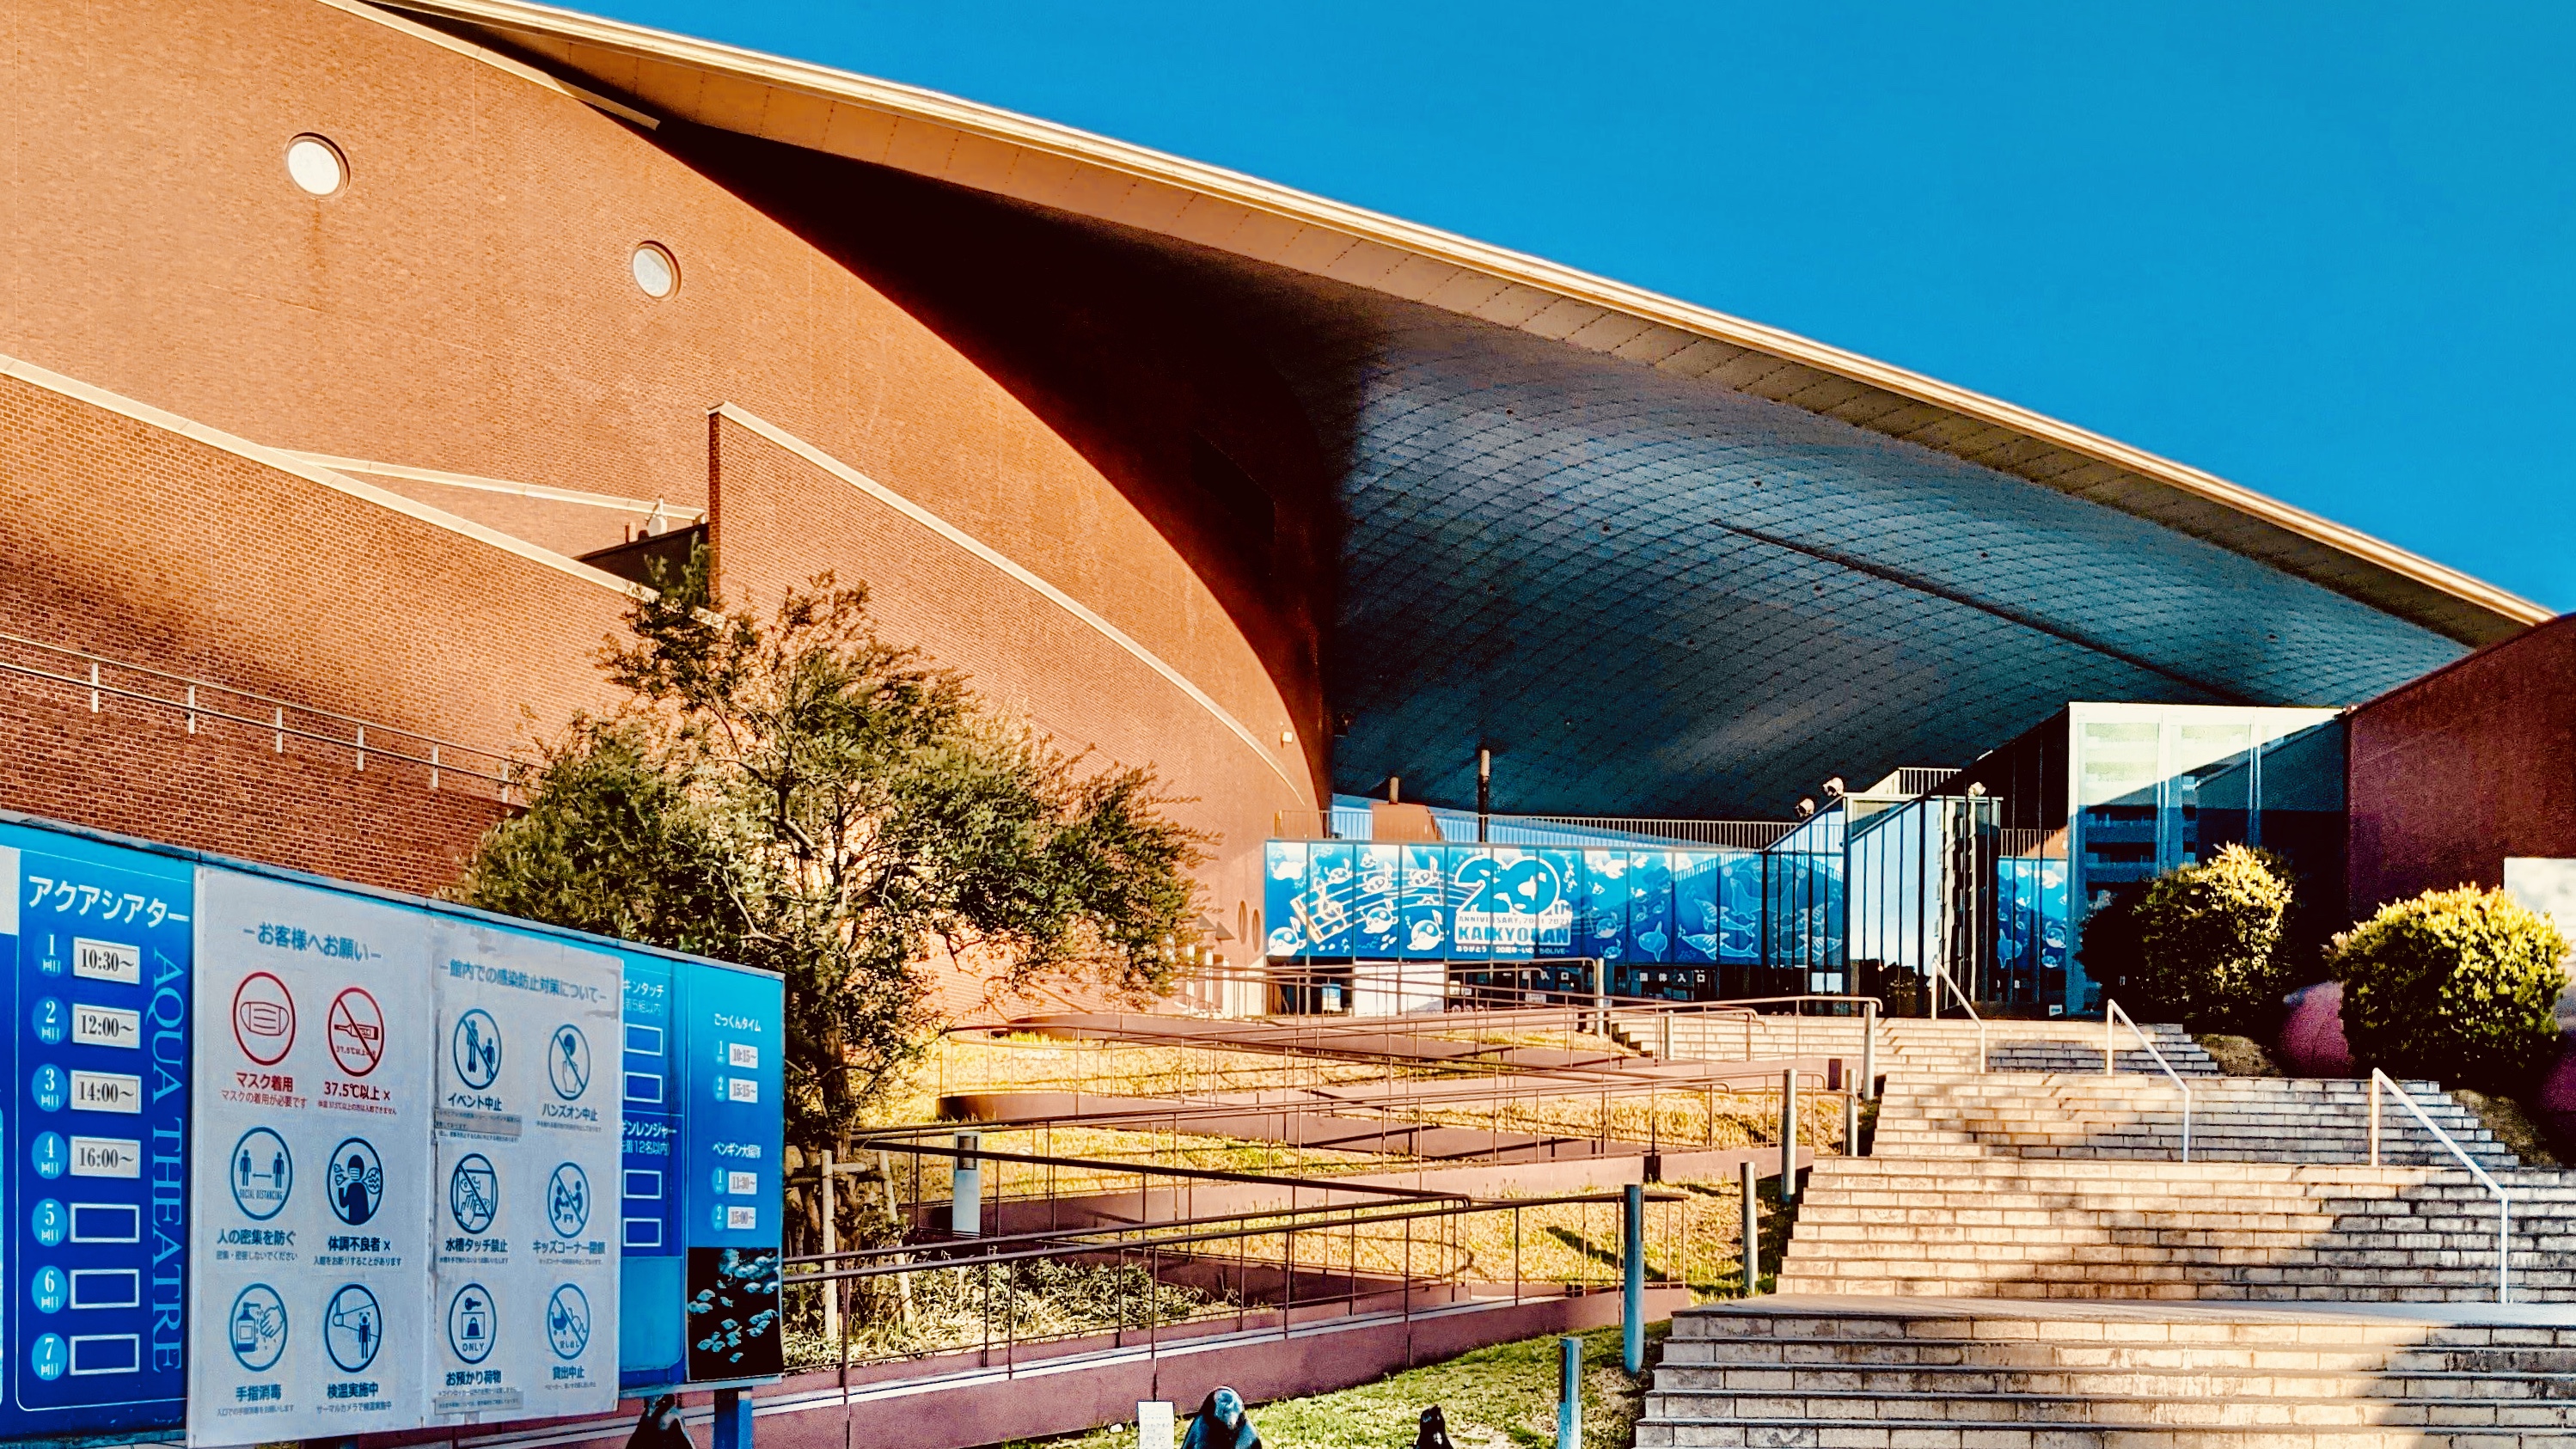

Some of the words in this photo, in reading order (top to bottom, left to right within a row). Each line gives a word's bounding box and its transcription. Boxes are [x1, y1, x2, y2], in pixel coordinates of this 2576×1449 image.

[28, 875, 190, 928] アクアシアター
[1459, 926, 1569, 943] KAIKYOKAN
[46, 1000, 56, 1024] 2
[714, 1012, 762, 1032] ごっくんタイム
[145, 946, 184, 1105] AQUA
[45, 1067, 55, 1091] 3
[236, 1072, 293, 1092] マスク着用
[221, 1090, 309, 1109] マスクの着用が必要です
[448, 1092, 503, 1112] イベント中止
[542, 1103, 598, 1122] ハンズオン中止
[45, 1135, 55, 1159] 4
[45, 1202, 55, 1226] 5
[152, 1116, 183, 1373] THEATRE
[217, 1228, 297, 1246] 人の密集を防ぐ
[328, 1236, 381, 1252] 体調不良者
[445, 1238, 509, 1253] 水槽タッチ禁止
[44, 1269, 55, 1293] 6
[44, 1337, 55, 1360] 7
[462, 1342, 485, 1353] ONLY
[445, 1369, 502, 1387] お預かり荷物
[553, 1366, 585, 1380] 貸出中止
[236, 1383, 282, 1403] 手指消毒
[327, 1380, 379, 1400] 検温実施中
[316, 1400, 393, 1415] サーマルカメラで検温実施中
